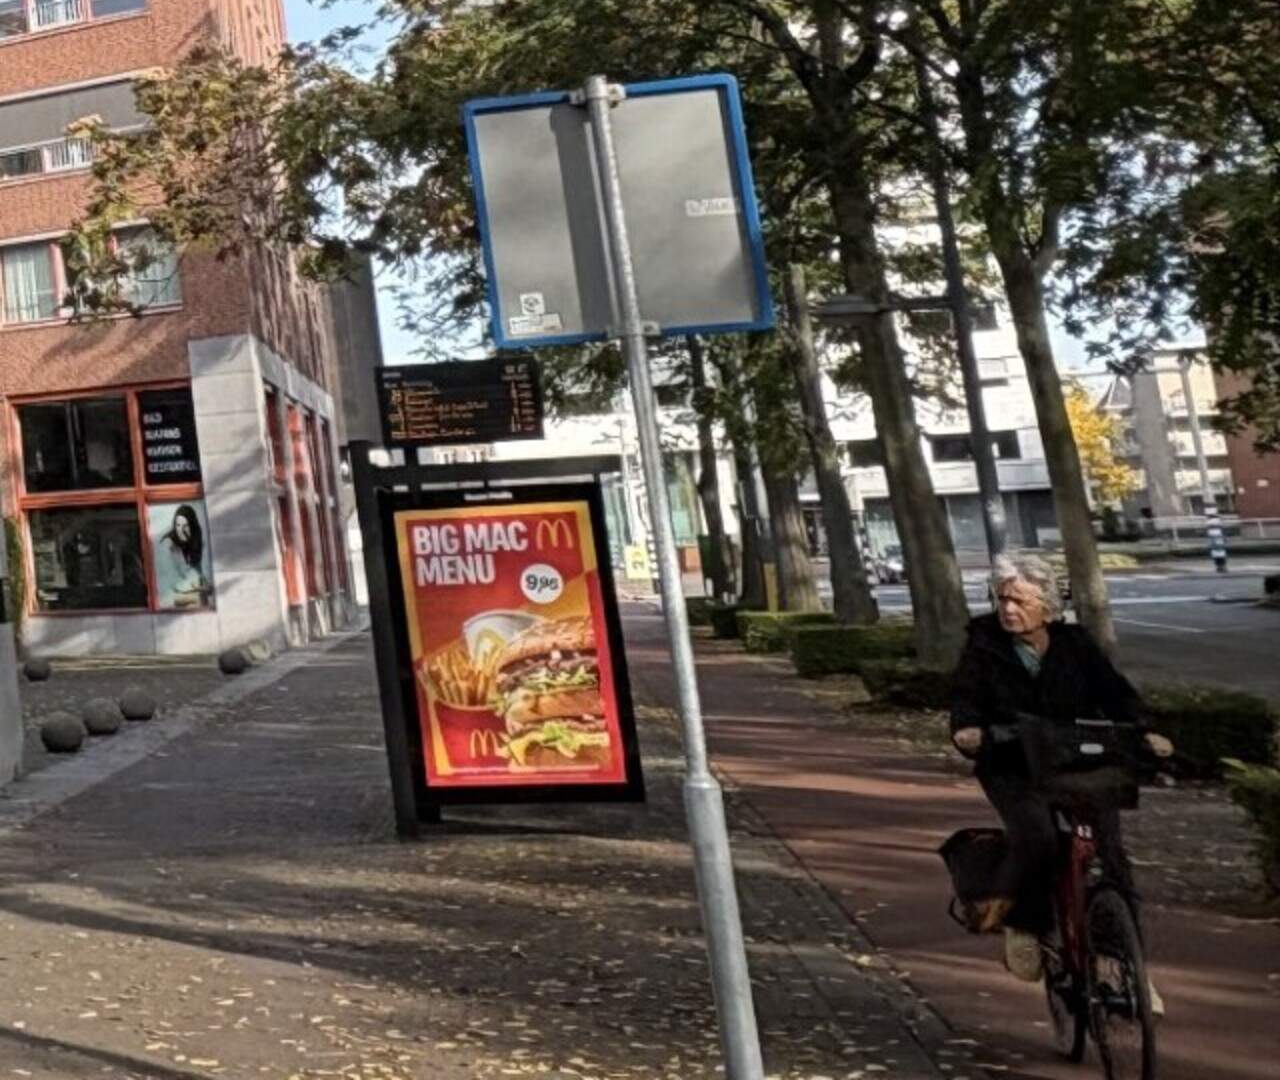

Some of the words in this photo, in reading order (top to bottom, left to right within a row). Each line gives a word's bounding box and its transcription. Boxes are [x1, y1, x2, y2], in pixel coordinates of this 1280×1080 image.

[413, 524, 460, 554] BIG
[463, 521, 528, 552] MAC
[416, 554, 496, 586] MENU
